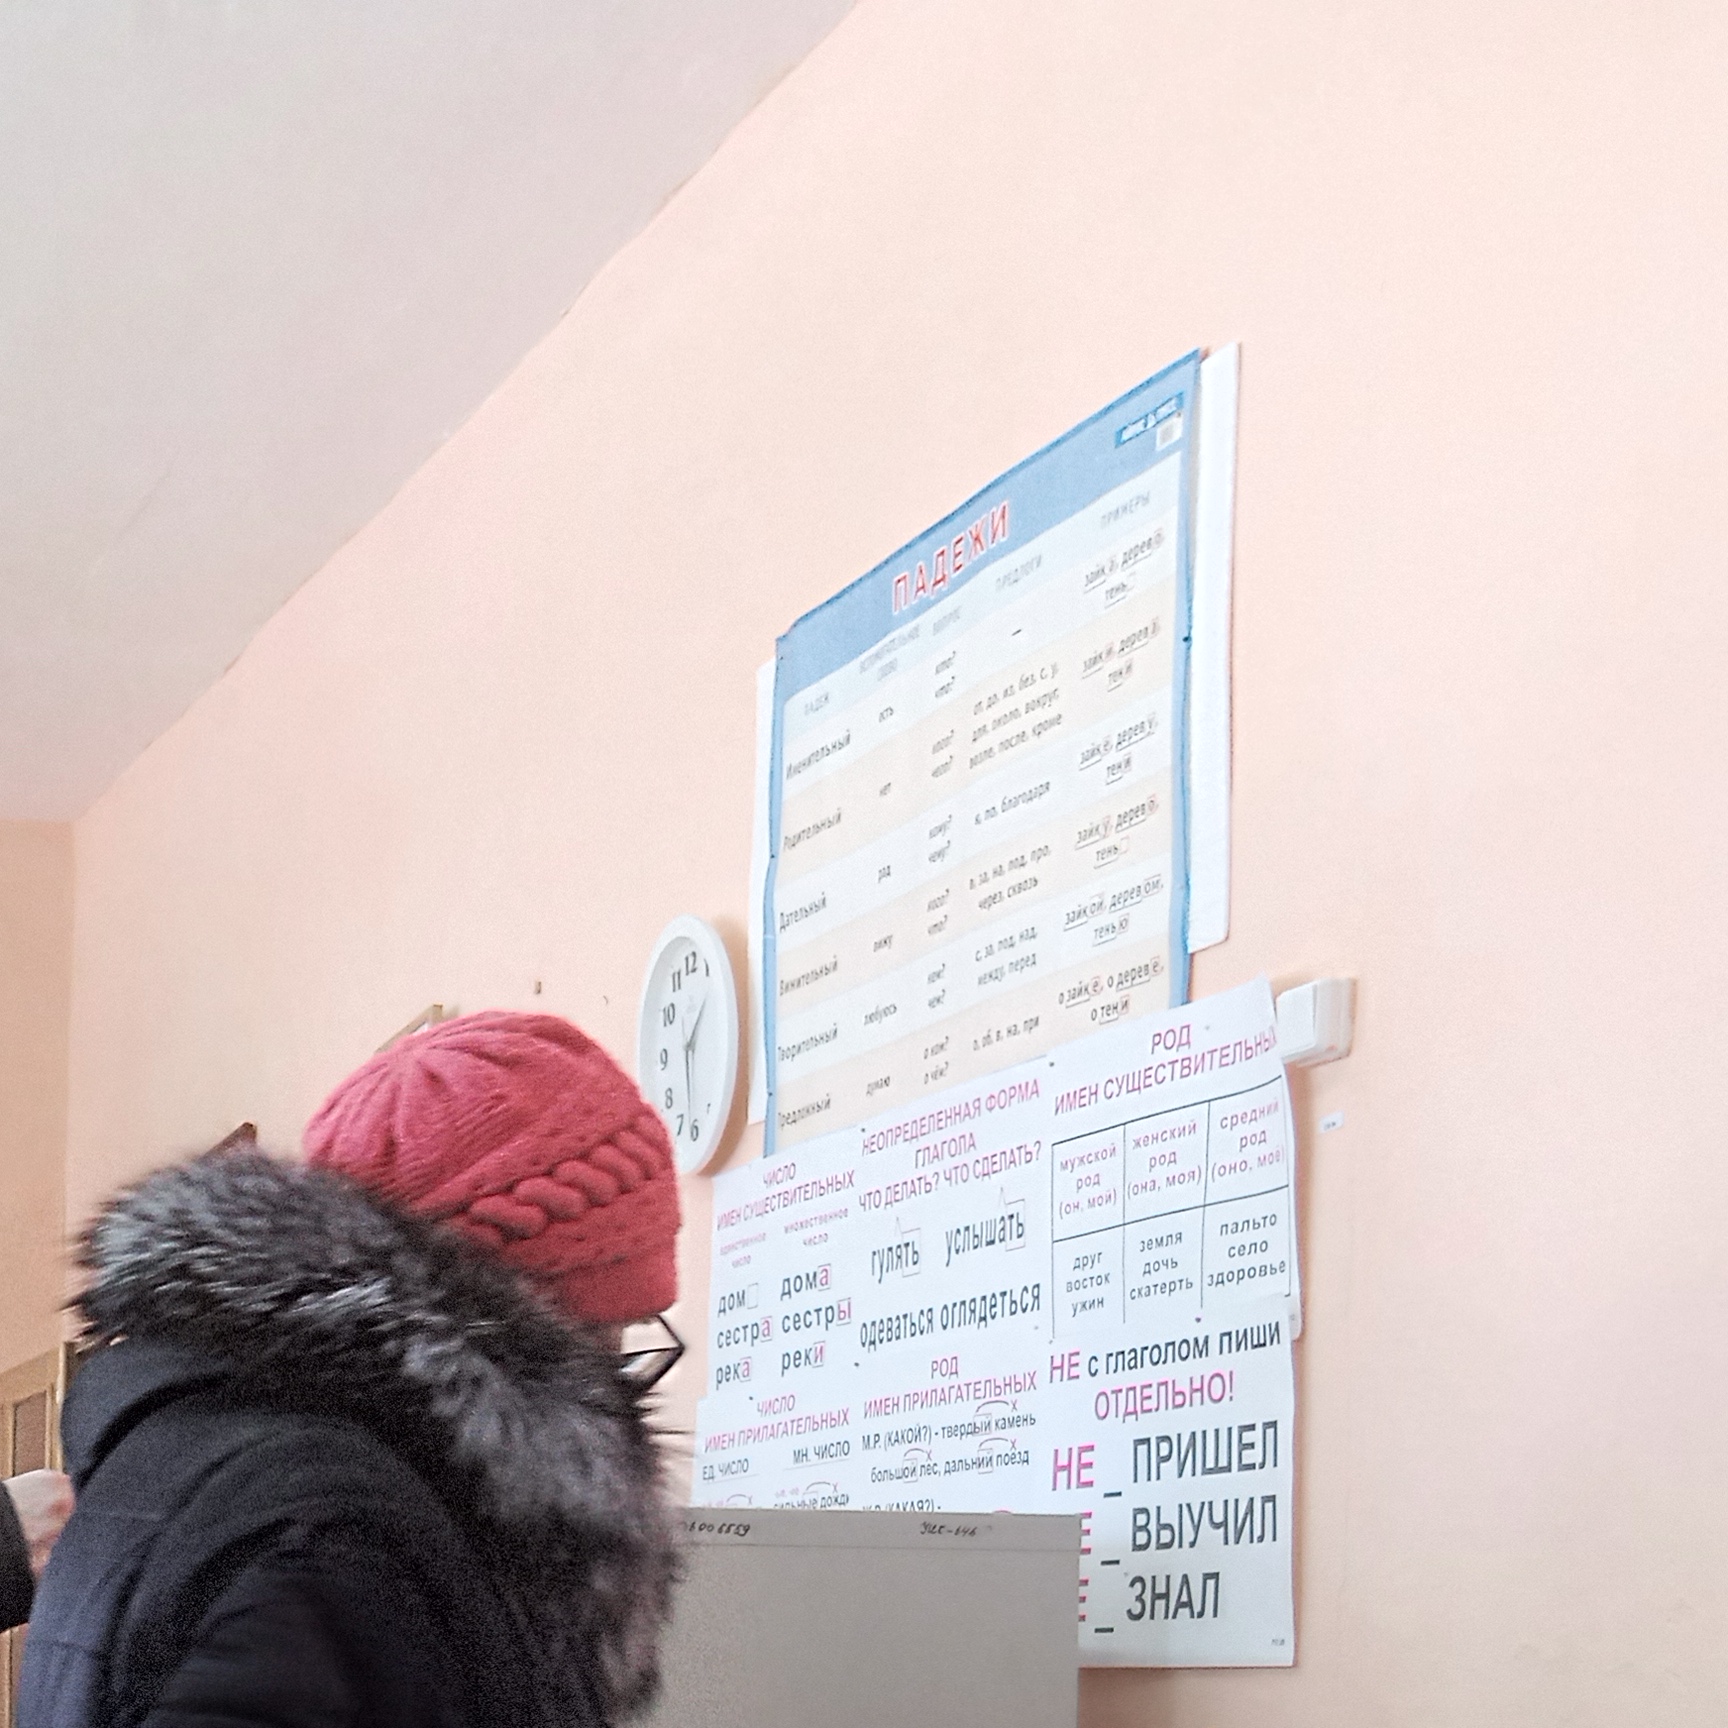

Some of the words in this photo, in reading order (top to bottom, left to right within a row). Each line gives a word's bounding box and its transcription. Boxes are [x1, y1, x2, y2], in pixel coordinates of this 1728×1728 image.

[892, 501, 1009, 614] ПАДЕЖИ
[783, 807, 841, 850] Родительный
[779, 892, 827, 933] Дательный
[684, 951, 697, 976] 12
[780, 955, 838, 996] Винительный
[672, 967, 682, 992] 11
[663, 1002, 676, 1027] 10
[1151, 1024, 1192, 1055] РОД
[659, 1048, 668, 1070] 9
[665, 1087, 673, 1109] 8
[1054, 1082, 1099, 1116] ИМЕН
[676, 1113, 685, 1136] 7
[862, 1097, 982, 1157] НЕОПРЕДЕЛЕННАЯ
[985, 1078, 1040, 1114] ФОРМА
[1220, 1097, 1279, 1132] средний
[690, 1118, 699, 1142] 6
[1132, 1121, 1197, 1150] женский
[1239, 1129, 1267, 1152] род
[914, 1132, 977, 1169] ГЛАГОЛА
[1060, 1143, 1117, 1173] мужской
[1149, 1150, 1177, 1172] род
[763, 1162, 796, 1188] ЧИСЛО
[859, 1189, 882, 1212] ЧТО
[884, 1171, 939, 1210] ДЕЛАТЬ?
[943, 1163, 969, 1188] ЧТО
[972, 1140, 1042, 1182] СДЕЛАТЬ?
[1076, 1172, 1101, 1193] род
[1127, 1179, 1161, 1200] (она,
[1166, 1165, 1203, 1187] моя)
[743, 1169, 855, 1221] СУЩЕСТВИТЕЛЬНЫХ
[945, 1212, 1025, 1267] услышать
[1220, 1213, 1278, 1237] пальто
[1139, 1232, 1183, 1252] земля
[1228, 1240, 1269, 1258] село
[872, 1240, 920, 1284] гулять
[1073, 1252, 1102, 1271] друг
[1142, 1257, 1178, 1277] дочь
[1207, 1260, 1286, 1287] здоровье
[781, 1267, 830, 1301] дома
[1066, 1272, 1111, 1293] восток
[1129, 1277, 1193, 1300] скатерть
[717, 1289, 746, 1318] дом
[782, 1300, 852, 1334] сестры
[860, 1306, 934, 1352] одеваться
[940, 1283, 1041, 1331] оглядеться
[1072, 1296, 1105, 1317] ужин
[717, 1318, 772, 1349] сестра
[781, 1345, 824, 1377] реки
[1049, 1350, 1080, 1384] НЕ
[1088, 1355, 1099, 1378] с
[1105, 1335, 1210, 1376] глаголом
[1219, 1320, 1281, 1356] пиши
[716, 1360, 751, 1390] река
[931, 1356, 959, 1379] РОД
[757, 1394, 796, 1417] ЧИСЛО
[864, 1396, 900, 1419] ИМЕН
[903, 1370, 1037, 1412] ПРИЛАГАТЕЛЬНЫХ
[1094, 1370, 1234, 1424] ОТДЕЛЬНО!
[705, 1431, 735, 1453] ИМЕН
[738, 1407, 850, 1447] ПРИЛАГАТЕЛЬНЫХ
[862, 1434, 882, 1451] М.Р.
[884, 1423, 932, 1451] (КАКОЙ?)
[941, 1415, 992, 1440] твердый
[994, 1413, 1036, 1432] камень
[718, 1458, 749, 1474] ЧИСЛО
[793, 1450, 811, 1465] МН.
[813, 1440, 850, 1459] ЧИСЛО
[871, 1461, 917, 1483] большой
[919, 1462, 941, 1478] лес,
[943, 1451, 993, 1476] дальний
[996, 1450, 1029, 1467] поезд
[1052, 1444, 1095, 1491] НЕ
[1133, 1420, 1278, 1483] ПРИШЕЛ
[1131, 1494, 1278, 1552] ВЫУЧИЛ
[1126, 1571, 1220, 1621] ЗНАЛ
